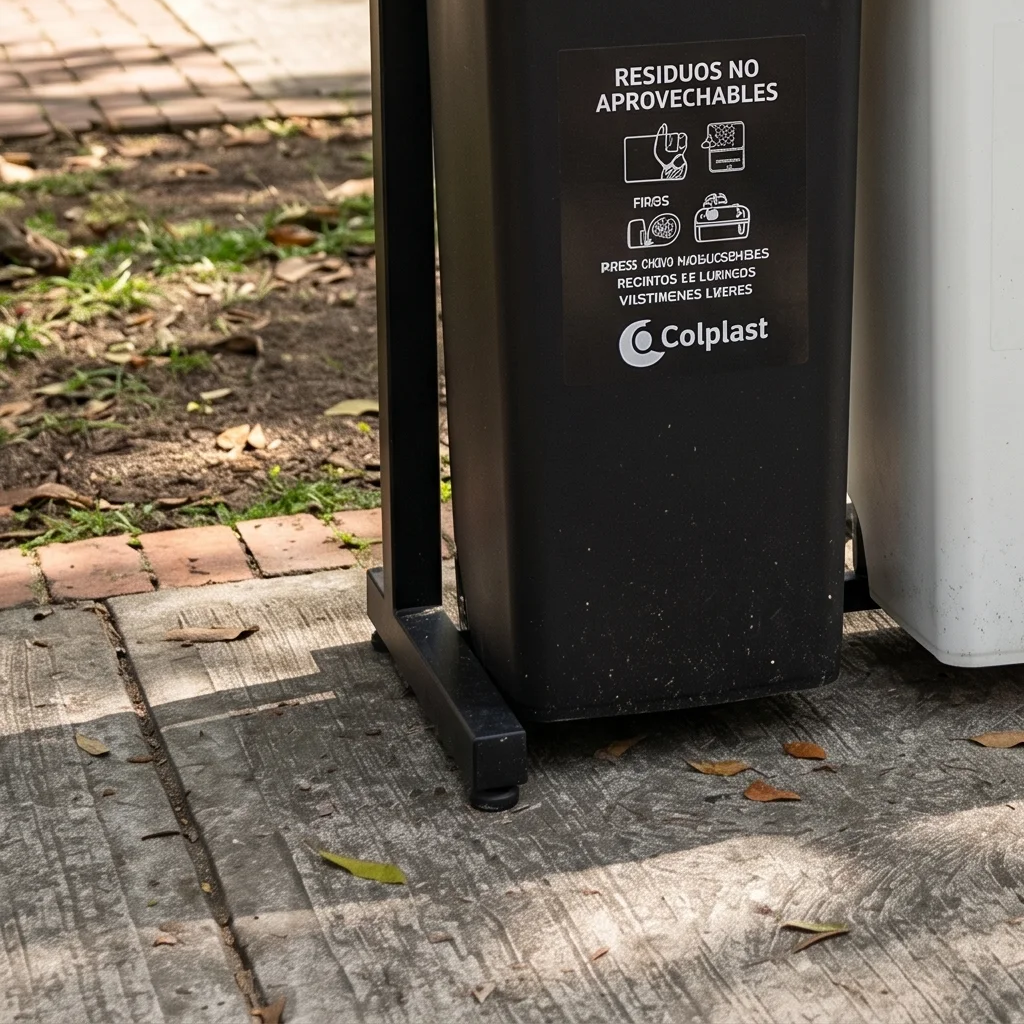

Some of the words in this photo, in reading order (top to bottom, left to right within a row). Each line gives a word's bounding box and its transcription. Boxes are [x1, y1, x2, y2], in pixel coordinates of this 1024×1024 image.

[615, 61, 722, 87] RESIDUOS
[728, 59, 760, 79] NO
[596, 82, 778, 113] APROVECHABLES
[617, 274, 677, 289] RECINTOS
[661, 317, 768, 351] Colplast
